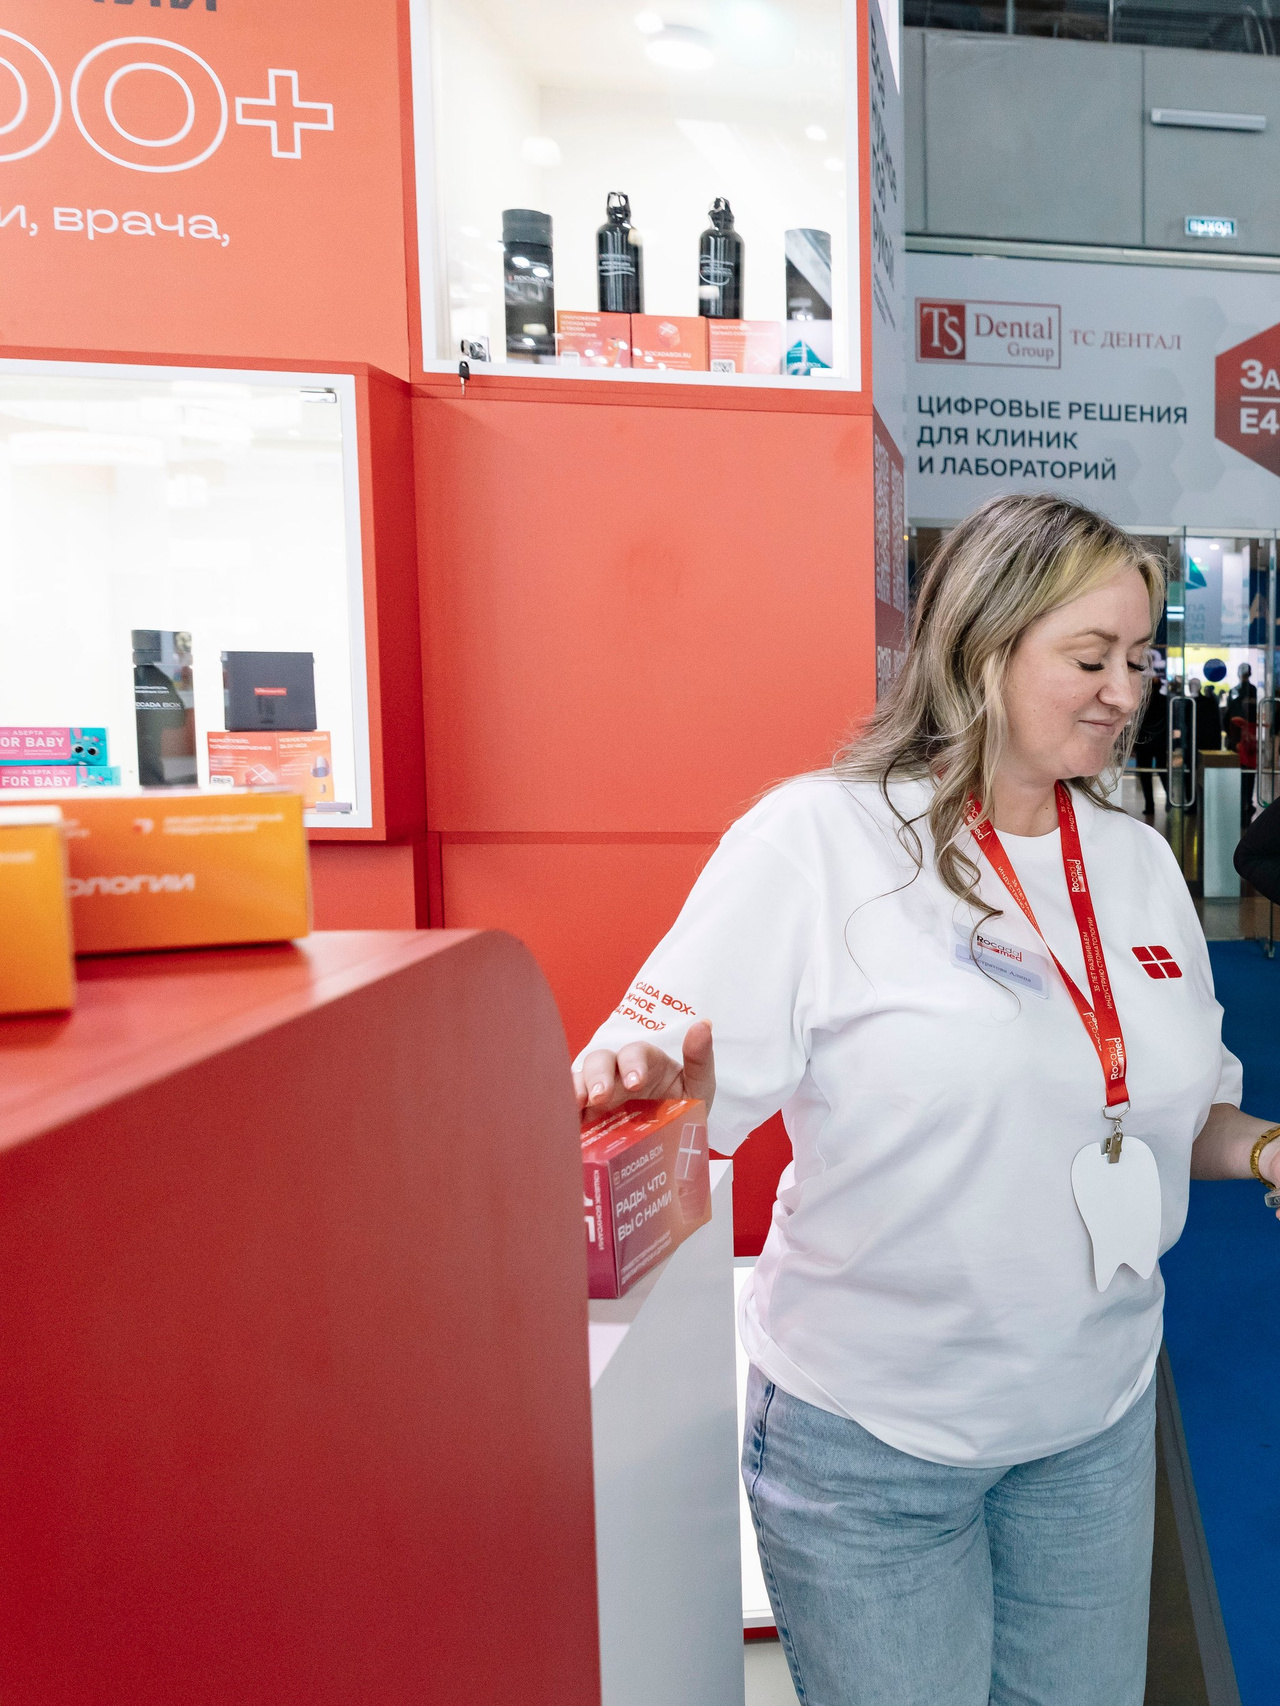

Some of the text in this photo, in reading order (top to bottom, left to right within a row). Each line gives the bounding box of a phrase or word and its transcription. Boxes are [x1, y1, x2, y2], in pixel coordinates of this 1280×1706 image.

[53, 206, 231, 247] врача,
[921, 306, 964, 356] TS
[974, 313, 1053, 341] Dental
[1069, 329, 1182, 350] ТС ДЕНТАЛ
[1007, 341, 1054, 362] Group
[917, 396, 1188, 424] ЦИФРОВЫЕ РЕШЕНИЯ
[917, 425, 1078, 449] ДЛЯ КЛИНИК
[918, 457, 1116, 480] И ЛАБОРАТОРИЙ
[25, 737, 65, 748] BABY
[2, 776, 72, 787] FOR BABY
[976, 935, 1020, 957] Rocada
[1083, 931, 1096, 971] РАЗВИВАЕМ
[1087, 916, 1113, 1009] ИНДУСТРИЮ СТОМАТОЛОГИИ
[1091, 971, 1099, 984] ЛЕТ
[636, 982, 696, 1016] CADA BOX-
[623, 1007, 667, 1032] РУКОЙ
[621, 1154, 650, 1179] ROCADA
[649, 1144, 664, 1160] BOX
[616, 1186, 647, 1218] РАДЫ,
[647, 1171, 667, 1192] ЧТО
[617, 1190, 672, 1242] ВЫ С НАМИ
